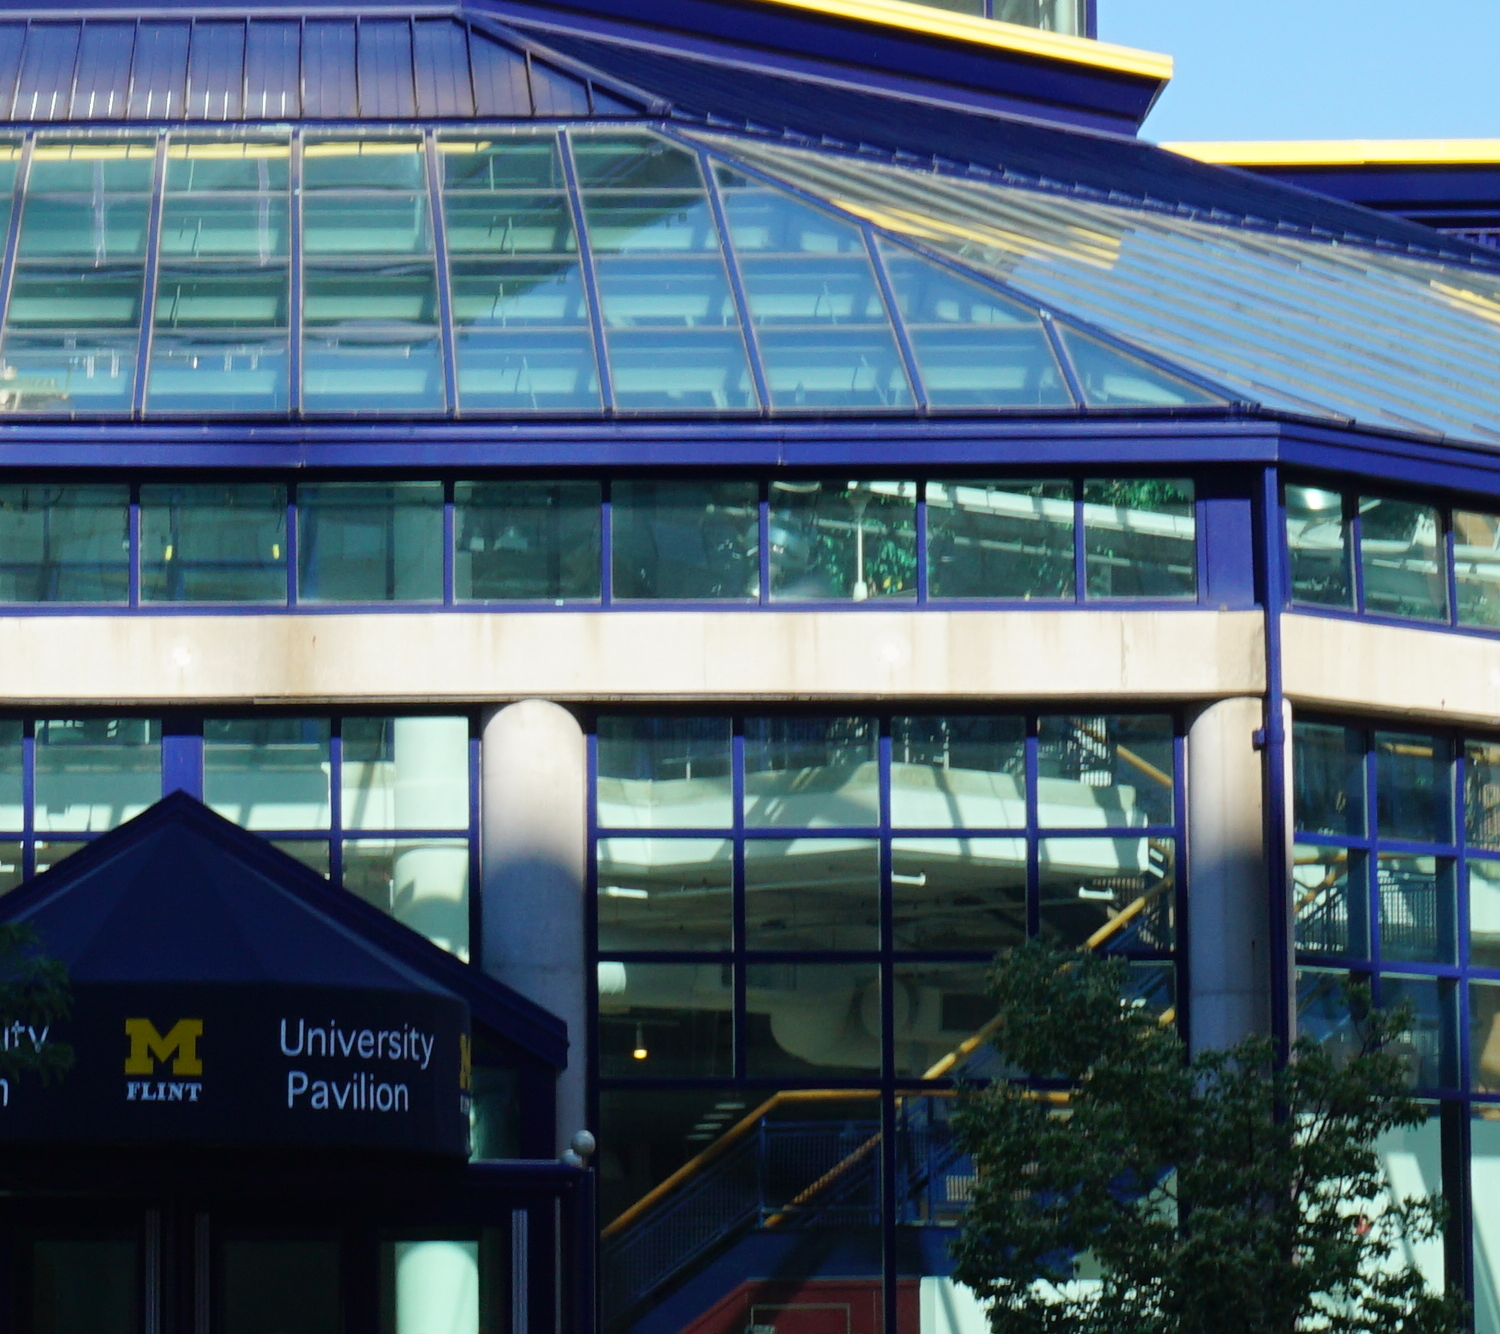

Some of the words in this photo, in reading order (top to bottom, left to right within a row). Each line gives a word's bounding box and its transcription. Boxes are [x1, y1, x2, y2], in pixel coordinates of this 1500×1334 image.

[124, 1018, 203, 1075] M
[280, 1018, 434, 1069] University
[126, 1081, 202, 1101] FLINT
[287, 1071, 409, 1112] Pavilion
